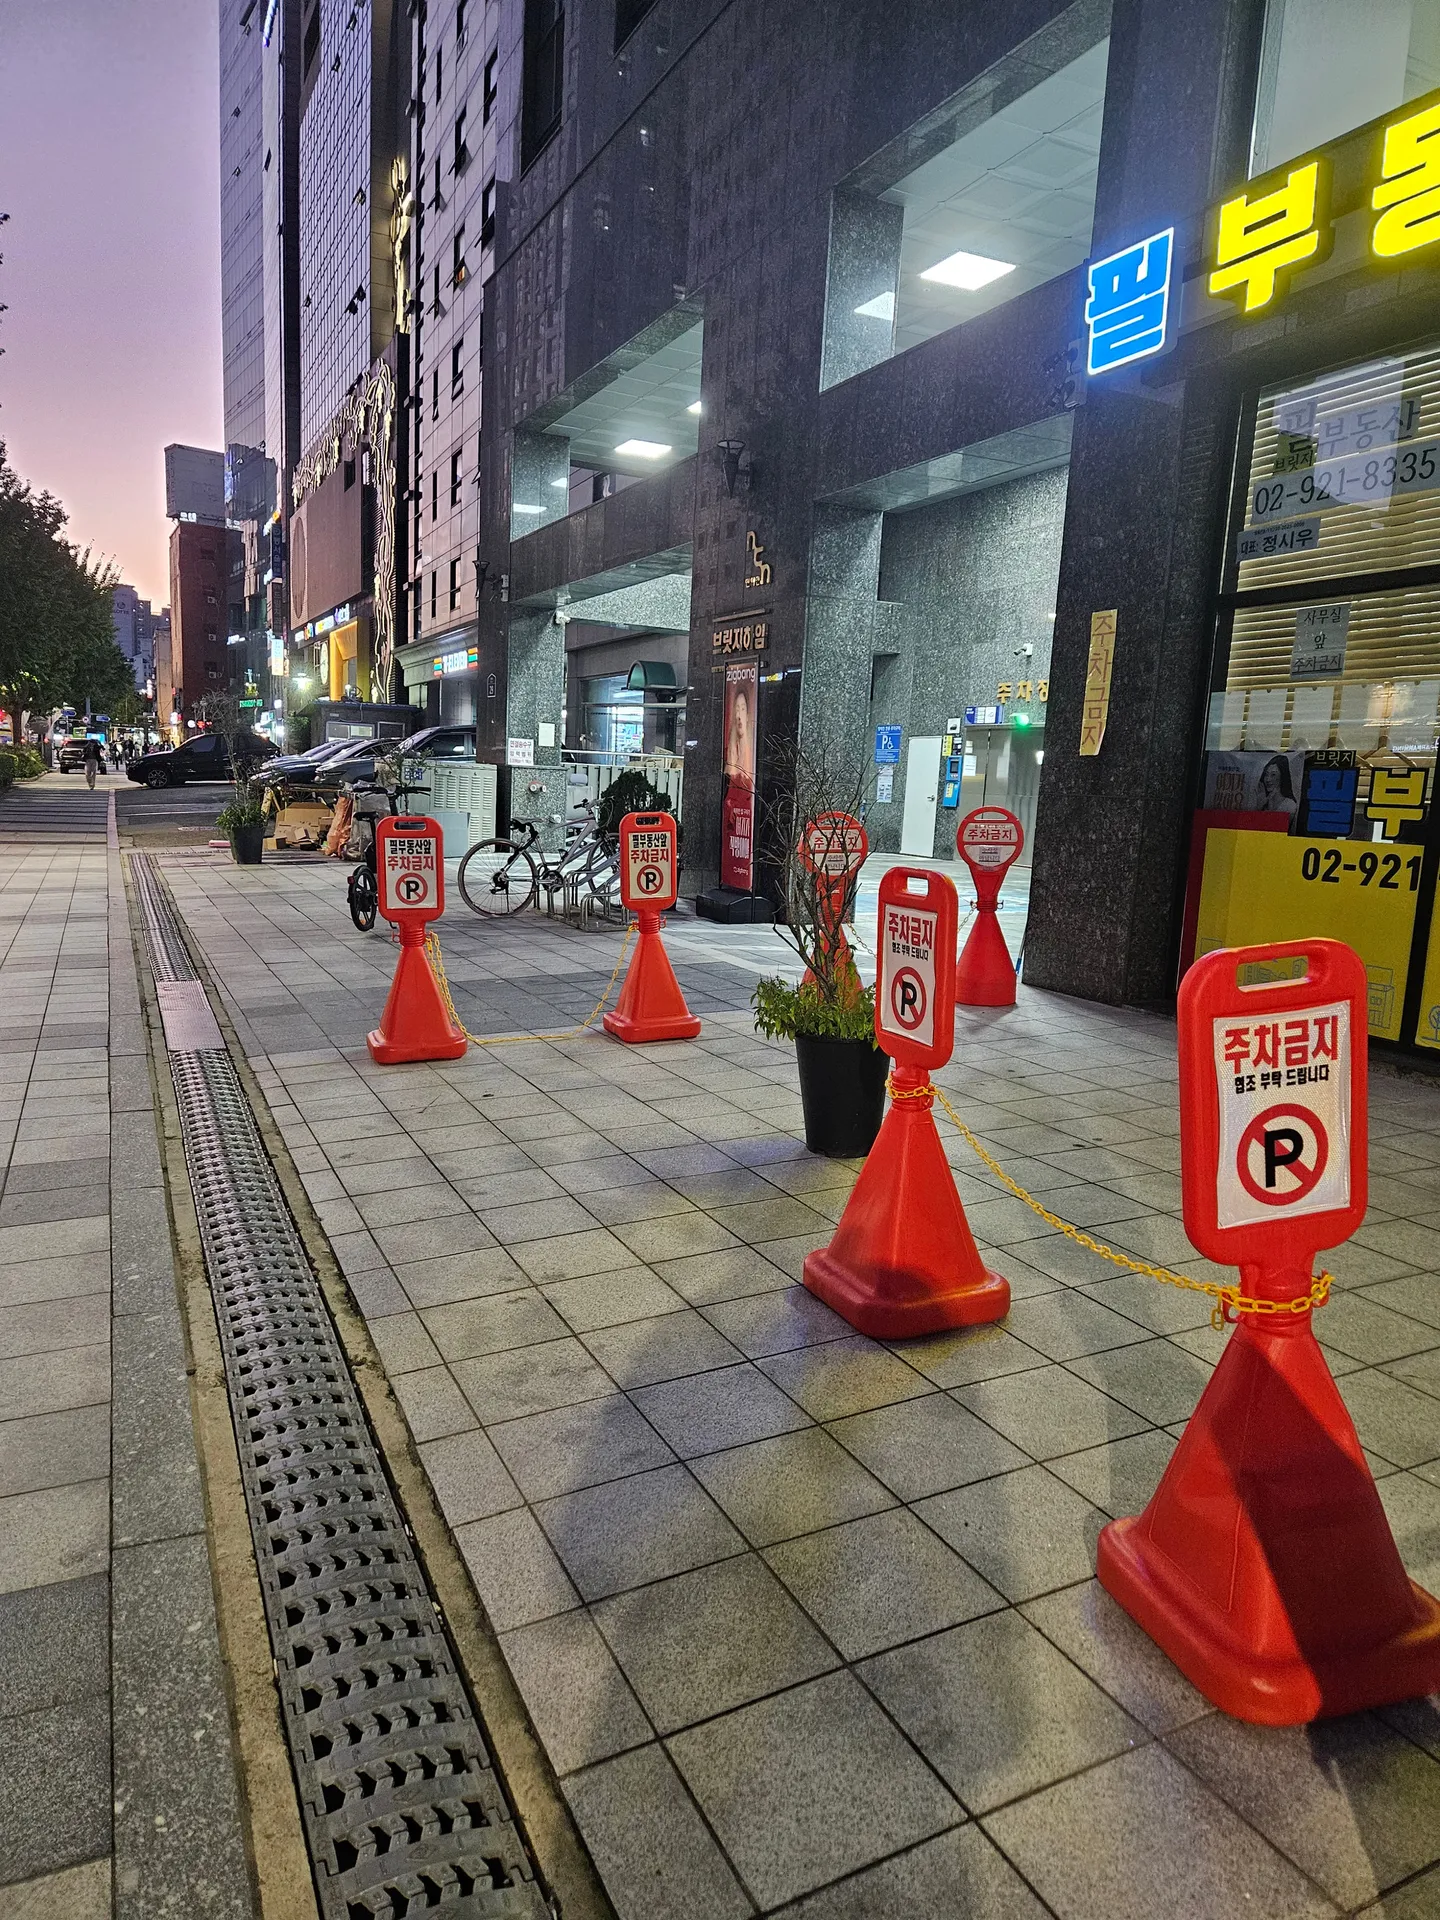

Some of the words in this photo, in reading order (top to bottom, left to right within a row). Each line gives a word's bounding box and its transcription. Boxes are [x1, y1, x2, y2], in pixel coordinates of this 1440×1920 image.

[1274, 450, 1314, 472] 브릿지
[1254, 448, 1436, 515] 02-921-8335
[1263, 529, 1313, 552] 정시우
[1303, 607, 1342, 625] 사무실
[1314, 634, 1327, 650] 앞
[1293, 654, 1342, 672] 주차금지
[726, 667, 756, 684] zigbang
[1081, 614, 1115, 746] 주차금지
[1314, 750, 1355, 767] 브릿지
[633, 833, 667, 848] 필부동산앞
[968, 829, 1012, 840] 주차금지
[390, 840, 431, 854] 필부동산앞
[631, 849, 668, 863] 주차금지
[388, 856, 434, 871] 주차금지
[1301, 847, 1422, 891] 02-921
[889, 912, 933, 949] 주차금지
[911, 947, 928, 961] 드립니다
[1224, 1015, 1338, 1074] 주차금지
[1234, 1075, 1256, 1094] 협조
[1260, 1071, 1282, 1090] 부탁
[1286, 1064, 1330, 1086] 드립니다
